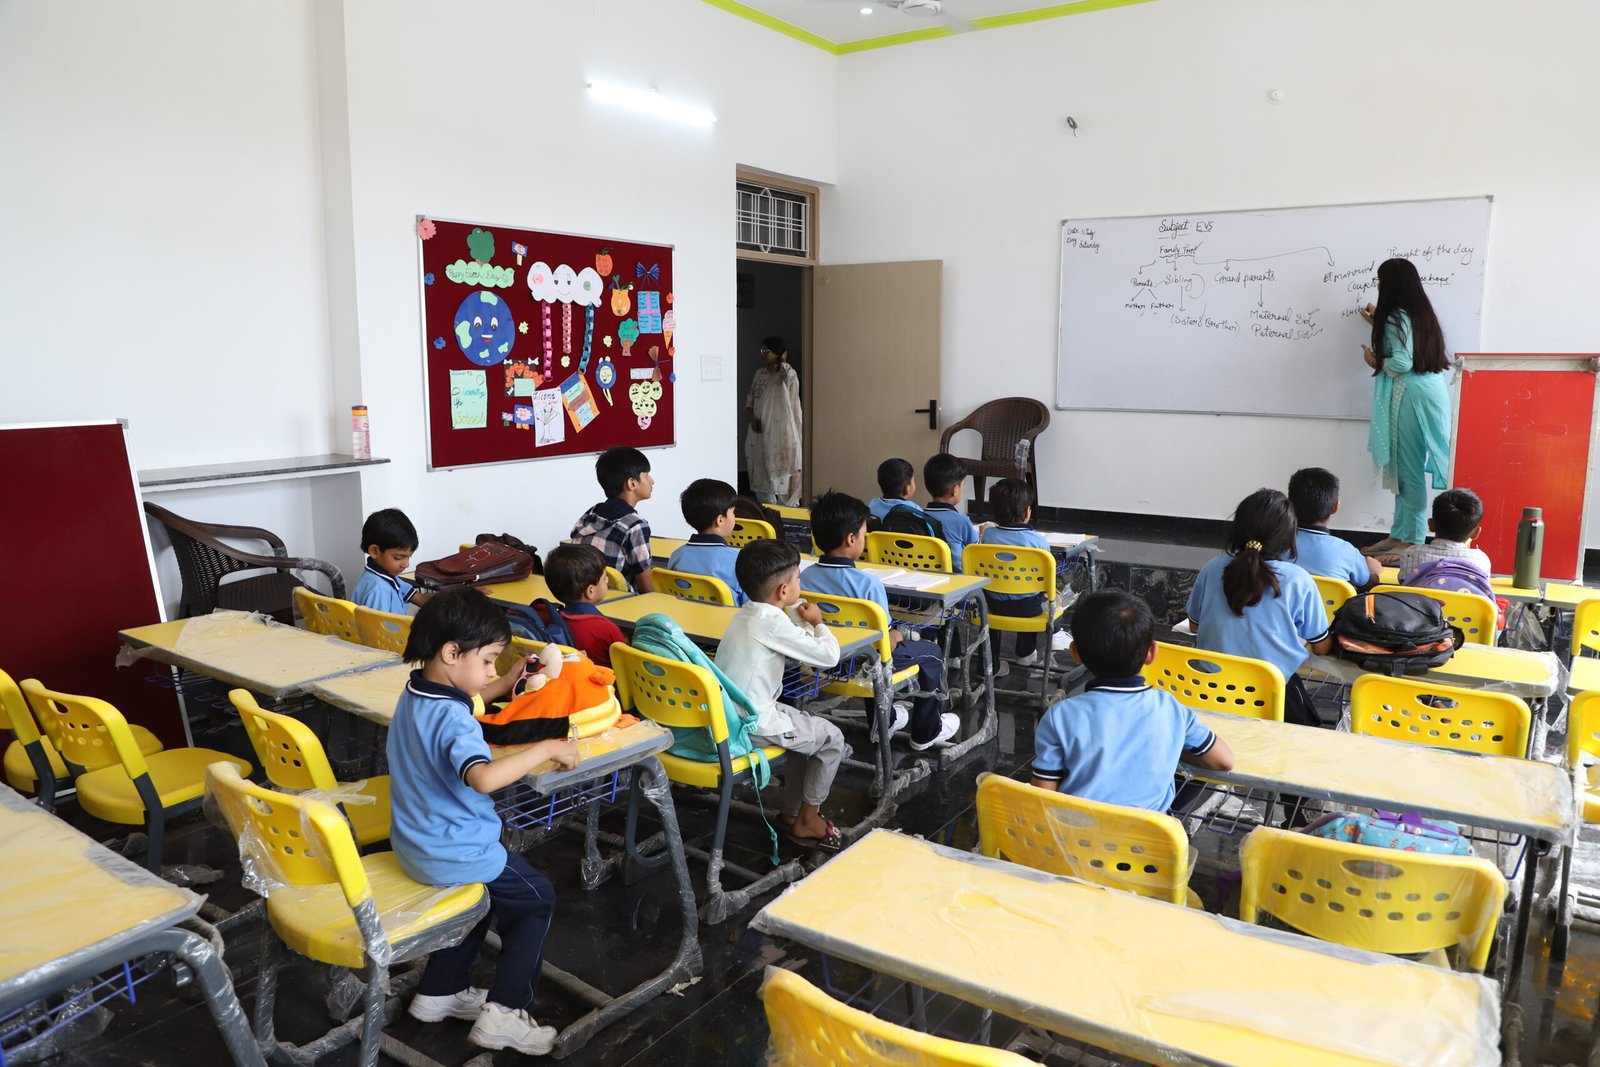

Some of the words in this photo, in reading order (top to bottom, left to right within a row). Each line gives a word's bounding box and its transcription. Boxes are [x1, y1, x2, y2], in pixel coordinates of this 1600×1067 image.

[1196, 220, 1215, 232] EVS
[1422, 245, 1435, 262] of
[1435, 243, 1452, 256] the
[1453, 242, 1476, 266] day
[1249, 307, 1293, 322] Maternal
[1250, 322, 1294, 340] Paternal
